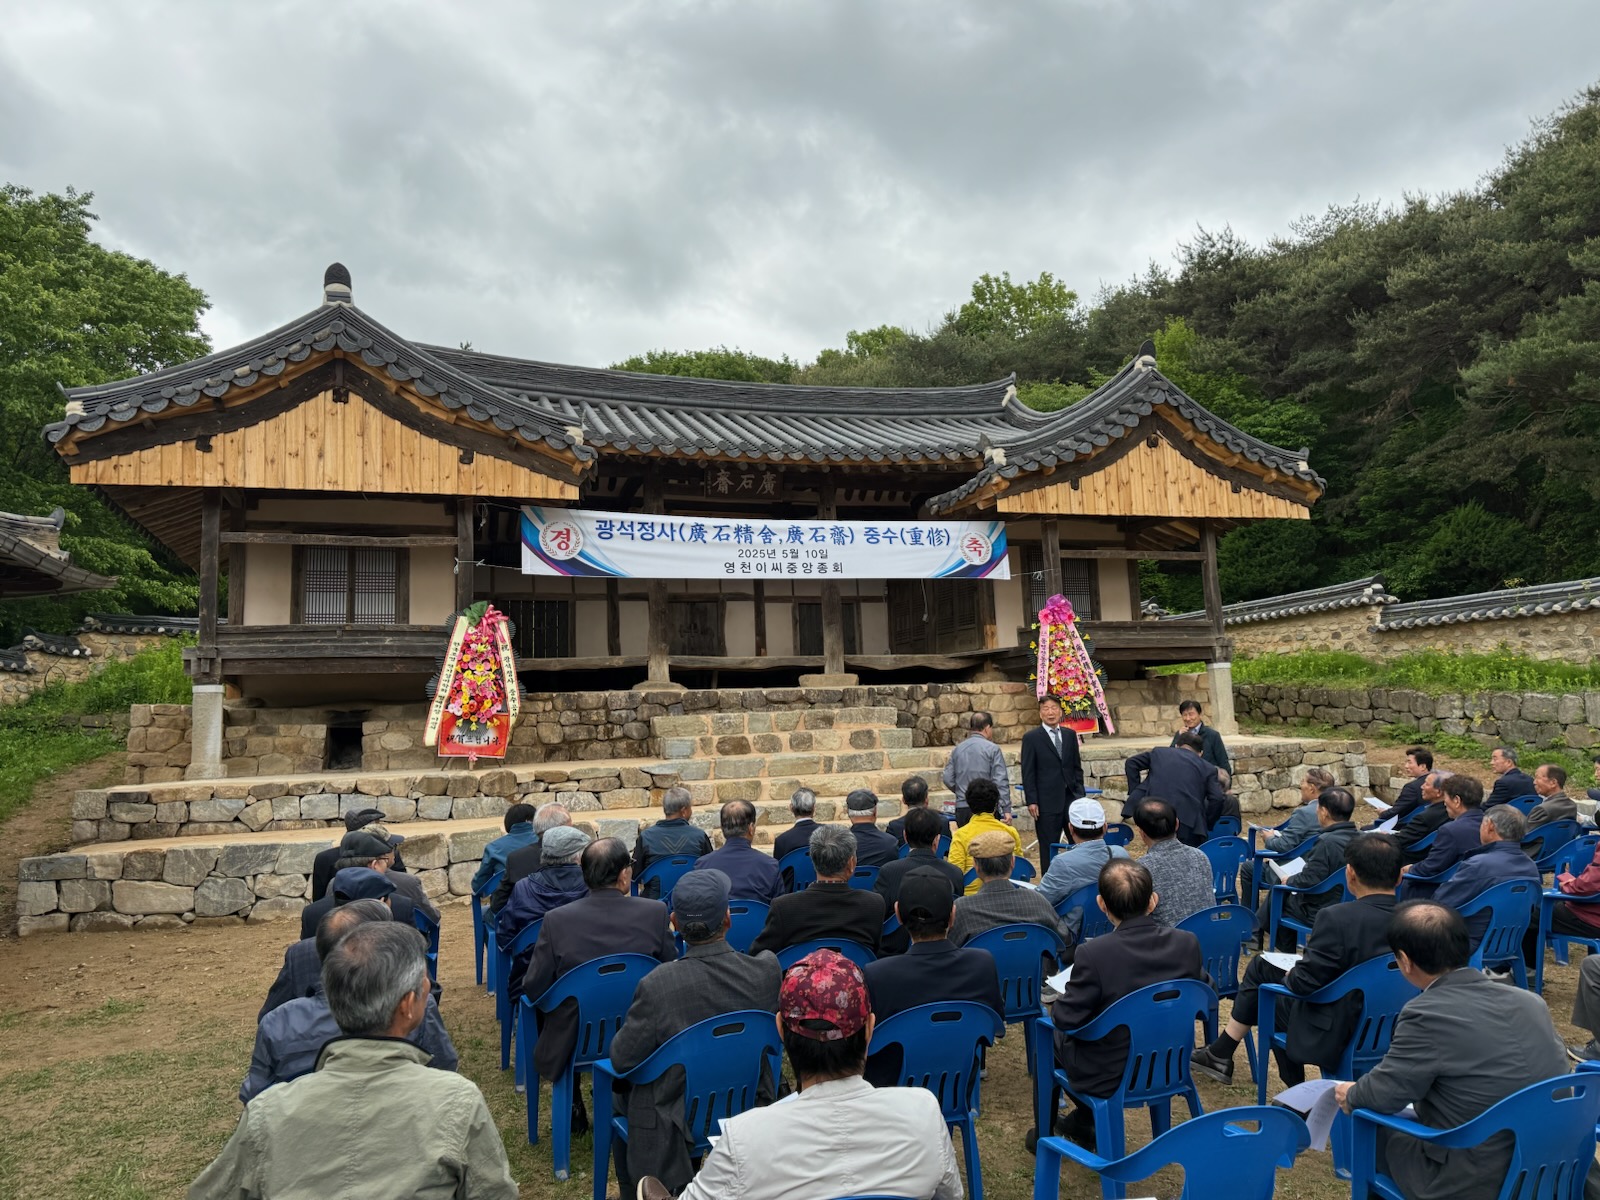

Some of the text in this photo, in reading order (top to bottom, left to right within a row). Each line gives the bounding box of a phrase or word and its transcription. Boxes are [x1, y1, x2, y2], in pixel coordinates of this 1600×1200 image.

[549, 527, 571, 551] 경
[863, 526, 950, 547] 중수(重修)
[965, 537, 985, 557] 축
[737, 548, 829, 559] 2025년 5월 10일
[503, 655, 515, 685] 광석정사
